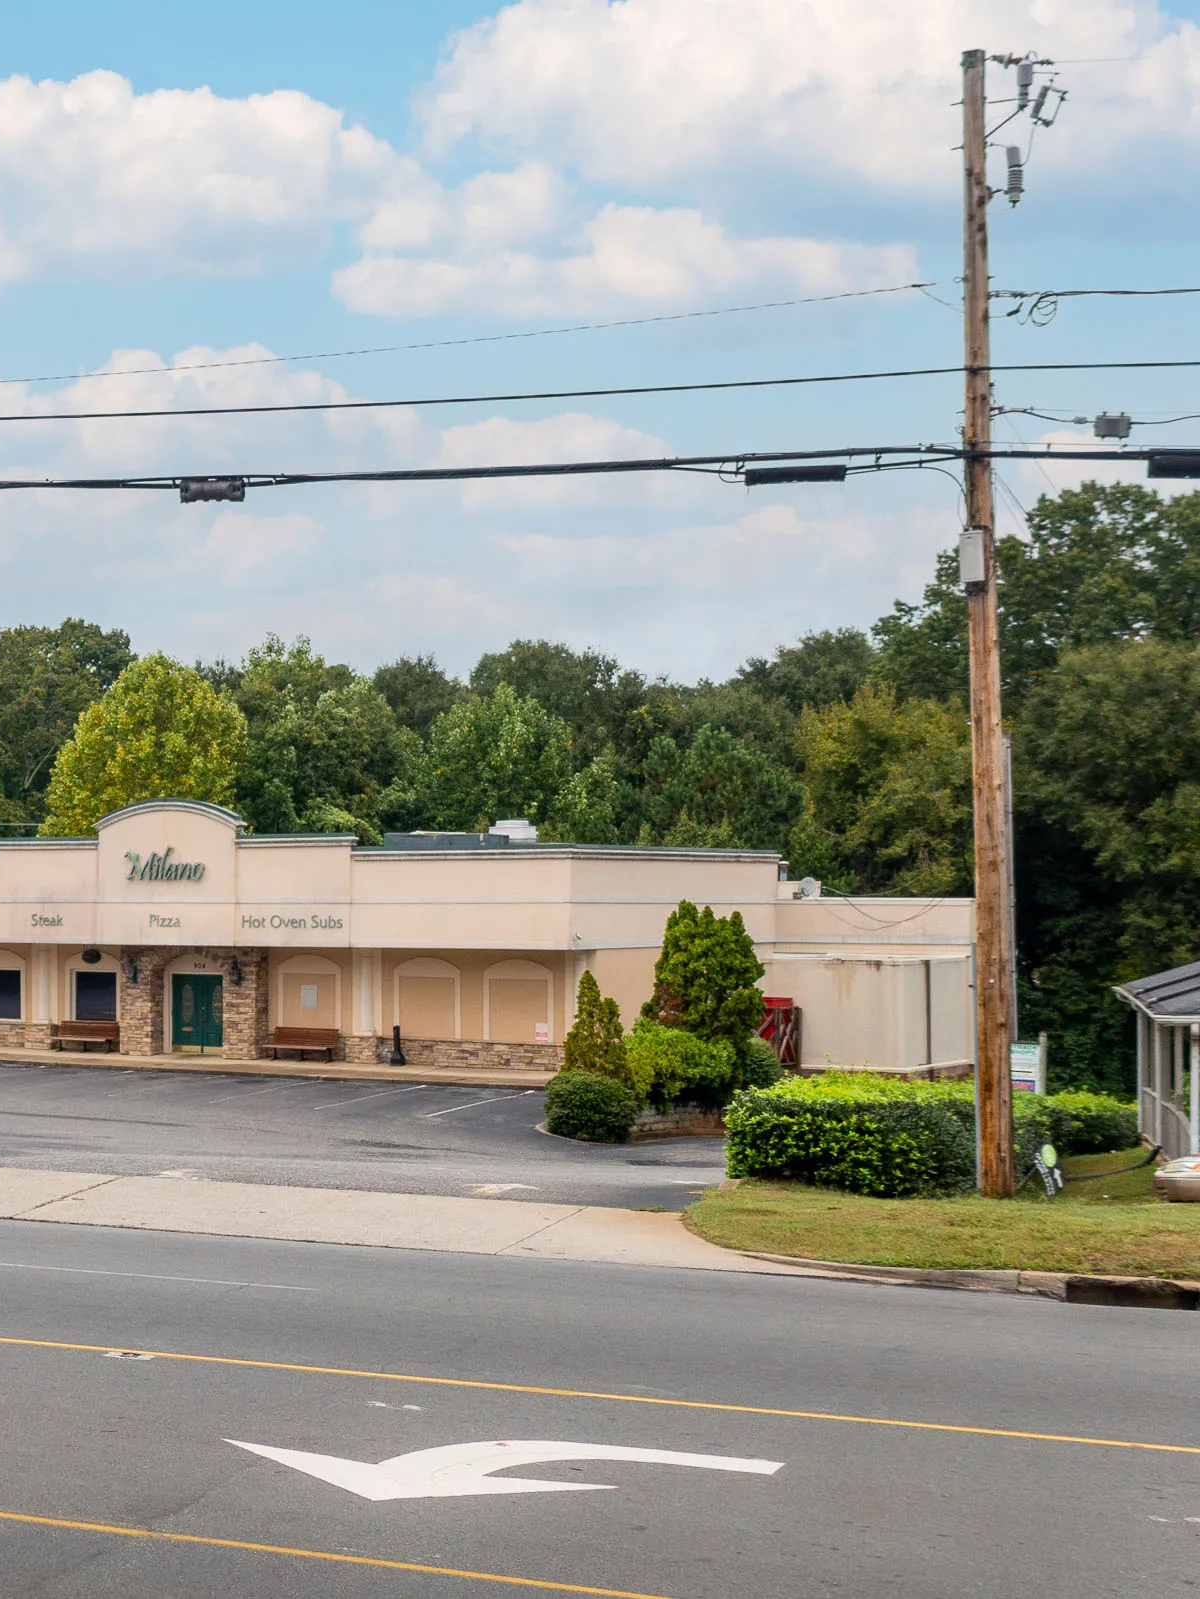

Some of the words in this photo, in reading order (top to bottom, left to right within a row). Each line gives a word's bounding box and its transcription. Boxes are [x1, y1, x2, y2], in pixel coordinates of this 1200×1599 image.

[124, 845, 206, 881] Milano
[31, 913, 63, 927] Steak
[149, 914, 181, 928] Pizza
[241, 915, 266, 928] Hot
[270, 914, 306, 929] Oven
[311, 914, 343, 929] Subs
